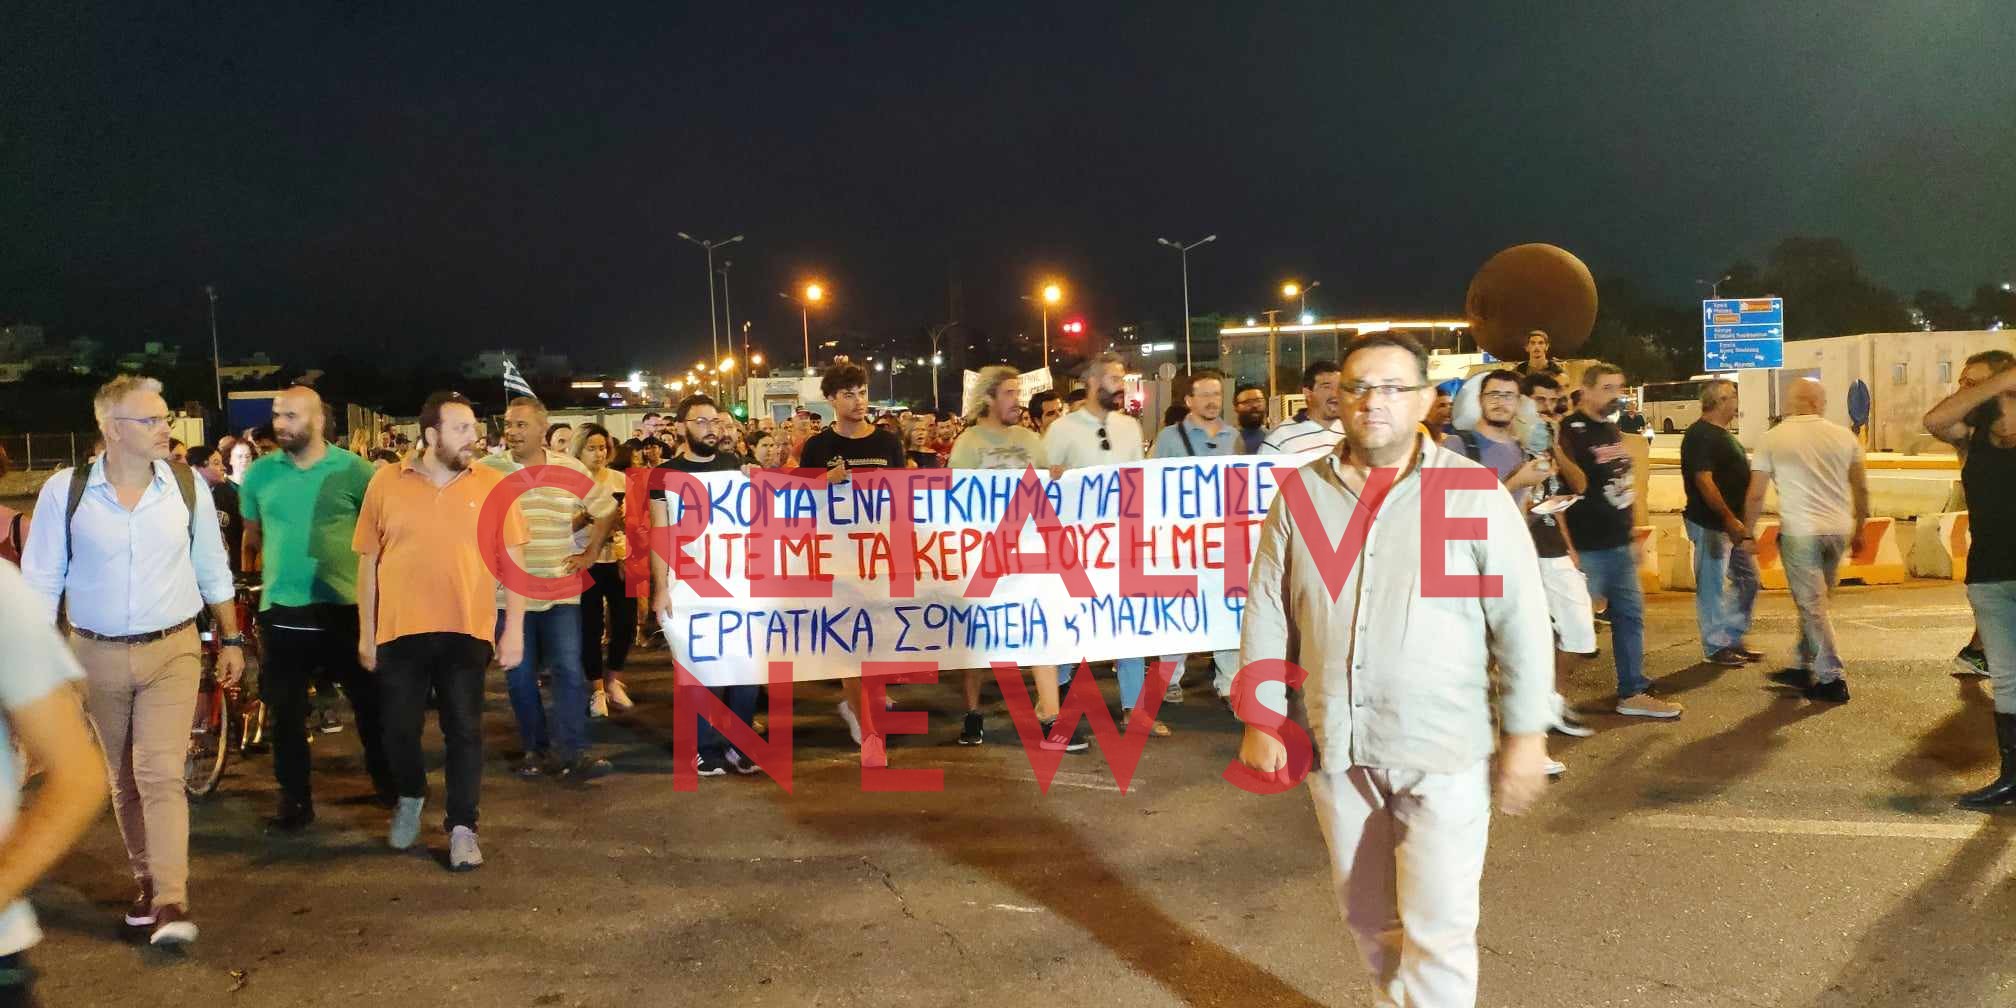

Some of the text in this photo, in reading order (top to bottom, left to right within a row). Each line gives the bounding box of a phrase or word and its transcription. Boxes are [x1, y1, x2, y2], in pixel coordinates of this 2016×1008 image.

[676, 462, 1275, 528] ΑΚΟΜΑ ΕΝΑ ΕΓΚΛΗΜΑ ΜΑΣ ΓΕΜΙΣΕ
[675, 532, 765, 581] ΕΙΤΕ
[780, 532, 834, 581] ΜΕ
[848, 532, 897, 581] ΤΑ
[911, 528, 1023, 581] ΚΕΡΔΗ
[1036, 522, 1116, 576] ΤΟΥΣ
[1171, 521, 1226, 570] ΜΕ
[1235, 519, 1265, 565] Τ
[688, 606, 874, 662] ΕΡΓΑΤΙΚΑ
[894, 598, 1048, 651] ΣΩΜΑΤΕΙΑ
